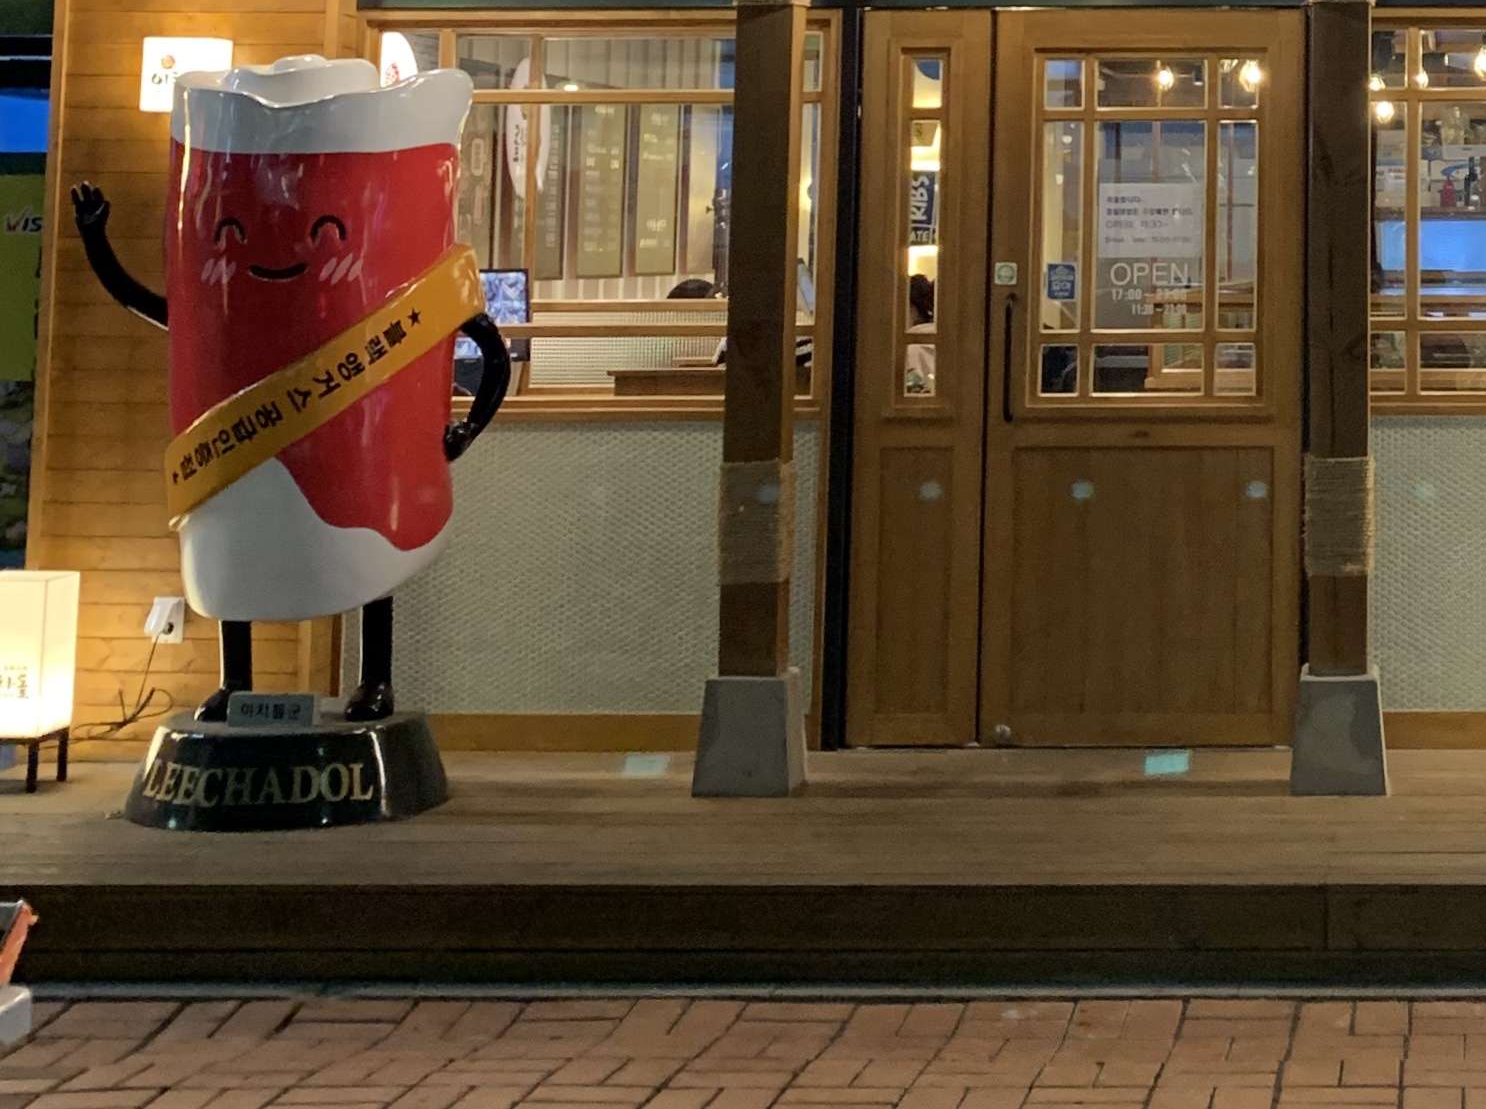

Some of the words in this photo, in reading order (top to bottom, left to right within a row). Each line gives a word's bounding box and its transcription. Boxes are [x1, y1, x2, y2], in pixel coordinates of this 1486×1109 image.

[1110, 262, 1189, 286] OPEN
[286, 319, 408, 414] 블랙앵거스
[143, 761, 375, 805] LEECHADOL
